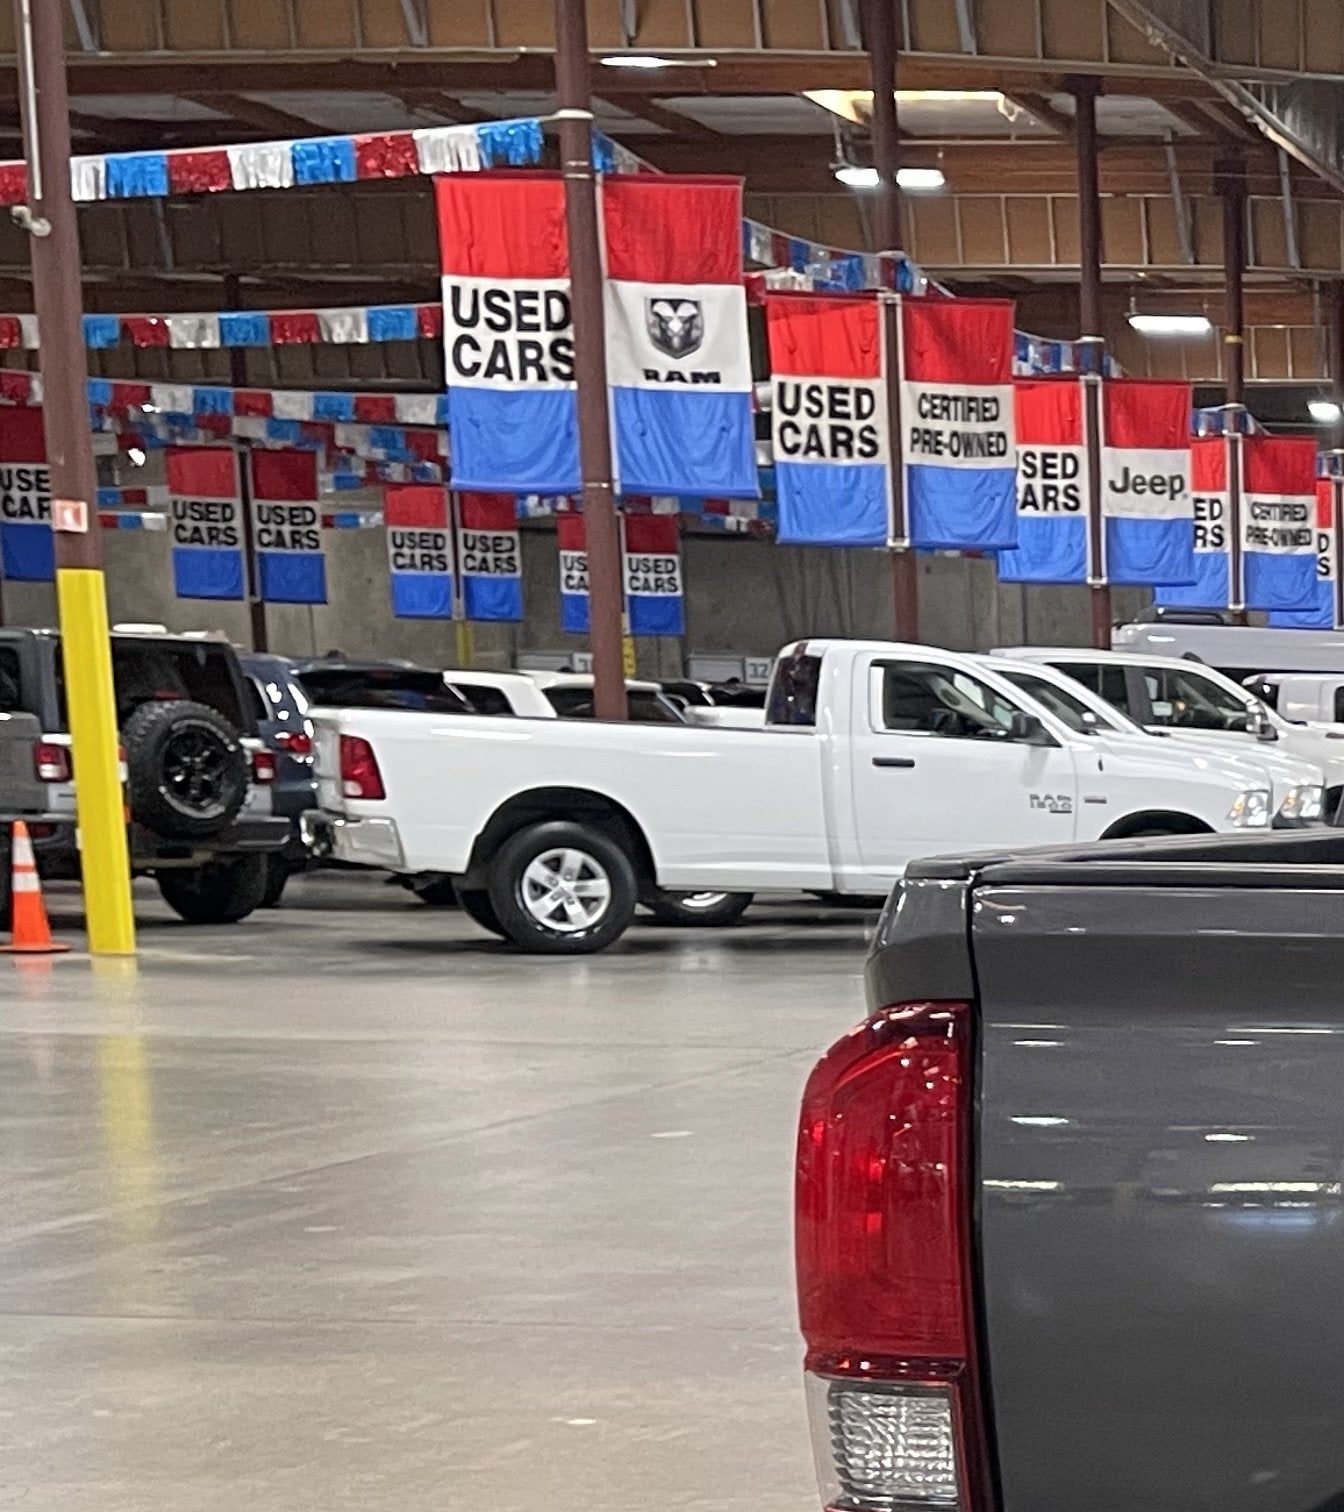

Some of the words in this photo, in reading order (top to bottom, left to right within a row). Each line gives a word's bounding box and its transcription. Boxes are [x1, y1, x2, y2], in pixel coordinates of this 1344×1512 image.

[451, 285, 572, 332] USED
[452, 334, 576, 382] CARS
[642, 369, 721, 384] RAM
[777, 382, 876, 420] USED
[918, 392, 1001, 422] CERTIFIED
[779, 420, 879, 458] CARS
[910, 427, 1008, 458] PRE-OWNED
[1017, 451, 1080, 479] SED
[0, 468, 50, 492] USE
[1109, 466, 1185, 500] Jeep
[2, 494, 50, 519] CAR
[1019, 483, 1081, 511] ARS
[172, 501, 235, 522] USED
[257, 504, 316, 527] USED
[1193, 498, 1223, 521] ED
[174, 523, 238, 546] CARS
[258, 528, 320, 550] CARS
[391, 531, 446, 551] USED
[463, 533, 515, 554] USED
[1193, 524, 1225, 548] RS
[393, 552, 448, 572] CARS
[464, 554, 517, 574] CARS
[563, 556, 588, 572] US
[628, 557, 676, 574] USED
[564, 574, 589, 591] CA
[628, 576, 679, 593] CARS
